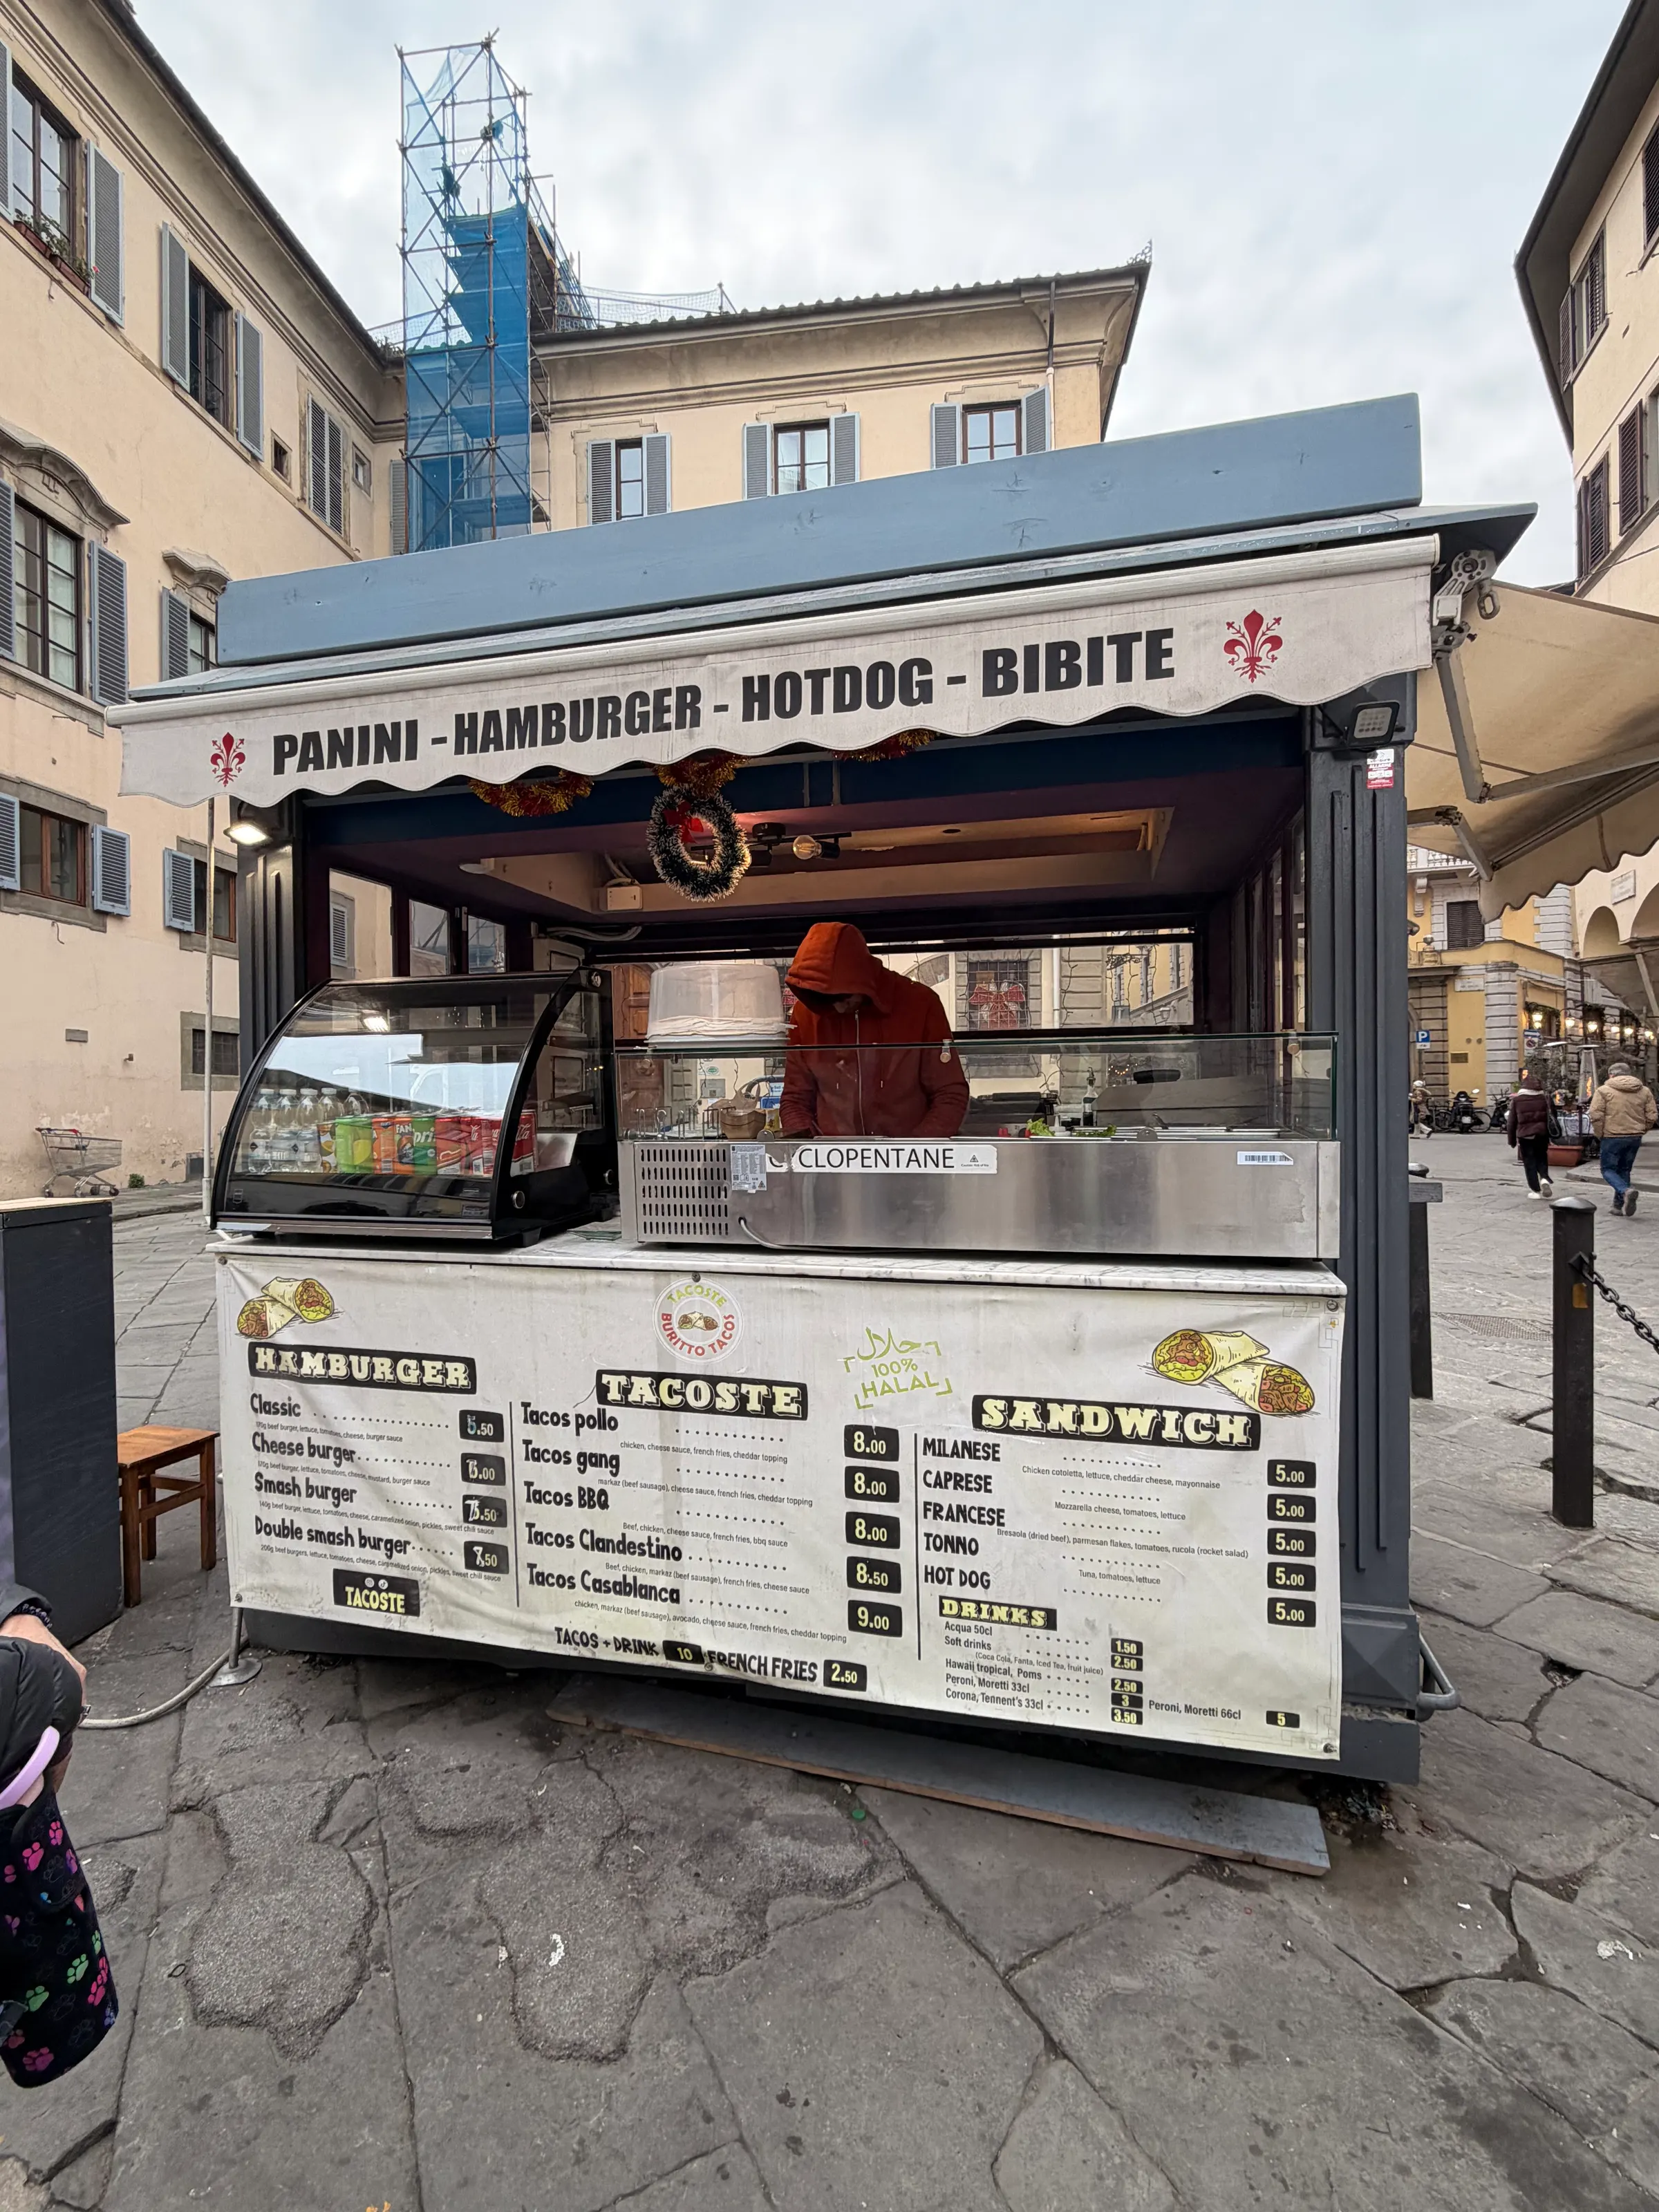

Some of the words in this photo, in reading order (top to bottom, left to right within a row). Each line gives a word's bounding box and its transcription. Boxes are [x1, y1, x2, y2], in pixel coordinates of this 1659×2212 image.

[274, 719, 418, 776] PANINI
[454, 684, 702, 756] HAMBURGER
[742, 657, 933, 722] HOTDOG
[982, 628, 1174, 697] BIBITE
[1418, 1031, 1427, 1042] P
[667, 1284, 727, 1308] TACOSTE
[661, 1313, 705, 1356] BURITTO
[708, 1314, 735, 1353] TACOS
[857, 1327, 921, 1360] حلال
[255, 1347, 471, 1389] HAMBURGER
[871, 1358, 918, 1378] 100%
[601, 1374, 802, 1418] TACOSTE
[861, 1371, 939, 1398] HALAL
[250, 1393, 301, 1417] Classic
[521, 1401, 571, 1427] Tacos
[574, 1407, 619, 1435] pollo
[981, 1398, 1252, 1447] SANDWICH
[252, 1431, 304, 1456] Cheese
[307, 1436, 356, 1468] burger
[620, 1441, 646, 1450] chicken,
[647, 1443, 671, 1452] cheese
[671, 1446, 692, 1454] sauce,
[693, 1446, 714, 1456] french
[715, 1448, 731, 1459] fries,
[733, 1450, 760, 1460] cheddar
[762, 1454, 787, 1465] topping
[854, 1432, 886, 1454] 8.00
[922, 1437, 1000, 1462] MILANESE
[522, 1438, 572, 1465] Tacos
[576, 1451, 620, 1477] gang
[854, 1472, 886, 1495] 8.00
[923, 1469, 993, 1494] CAPRESE
[1022, 1465, 1050, 1475] Chicken
[1051, 1469, 1084, 1479] cotoletta,
[1085, 1470, 1112, 1481] lettuce,
[1113, 1473, 1143, 1483] cheddar
[1145, 1476, 1174, 1486] cheese,
[1175, 1480, 1220, 1489] mayonnaise
[1275, 1464, 1304, 1483] 5.00
[254, 1471, 301, 1497] Smash
[305, 1477, 357, 1508] burger
[523, 1480, 573, 1507] Tacos
[577, 1485, 610, 1510] BBQ
[598, 1478, 621, 1486] markaz
[621, 1479, 638, 1492] (beef
[639, 1482, 670, 1492] sausage),
[671, 1484, 694, 1494] cheese
[695, 1488, 716, 1497] sauce,
[717, 1488, 738, 1498] french
[740, 1490, 756, 1501] fries,
[758, 1493, 785, 1503] cheddar
[786, 1497, 813, 1508] topping
[923, 1501, 1005, 1527] FRANCESE
[1055, 1501, 1092, 1512] Mozzarella
[1094, 1505, 1121, 1515] cheese,
[1123, 1508, 1159, 1519] tomatoes,
[1160, 1510, 1186, 1520] lettuce
[1275, 1498, 1304, 1517] 5.00
[254, 1515, 303, 1540] Double
[306, 1526, 355, 1547] smash
[357, 1527, 411, 1560] burger
[525, 1521, 574, 1549] Tacos
[579, 1528, 682, 1562] Clandestino
[623, 1521, 639, 1531] Beef,
[639, 1524, 666, 1535] chicken,
[666, 1527, 690, 1537] cheese
[691, 1531, 712, 1540] sauce,
[713, 1532, 734, 1541] french
[735, 1534, 752, 1544] fries,
[753, 1536, 767, 1546] bbq
[854, 1518, 887, 1541] 8.00
[924, 1532, 979, 1556] TONNO
[997, 1528, 1027, 1538] Bresaola
[1028, 1531, 1049, 1541] (dried
[1050, 1533, 1071, 1544] beef),
[1072, 1537, 1108, 1546] parmesan
[1109, 1539, 1133, 1550] flakes,
[1134, 1542, 1170, 1553] tomatoes,
[1172, 1546, 1195, 1554] rucola
[1197, 1546, 1223, 1556] (rocket
[1225, 1549, 1248, 1559] salad)
[1275, 1533, 1304, 1552] 5.00
[526, 1562, 576, 1590] Tacos
[580, 1569, 680, 1604] Casablanca
[856, 1562, 888, 1586] 8.50
[924, 1564, 955, 1586] HOT
[959, 1568, 991, 1590] DOG
[1078, 1569, 1097, 1579] Tuna,
[1098, 1572, 1134, 1583] tomatoes,
[1136, 1575, 1161, 1584] lettuce
[1275, 1566, 1304, 1586] 5.00
[345, 1586, 405, 1613] TACOSTE
[941, 1598, 1047, 1624] DRINKS
[857, 1606, 889, 1630] 9.00
[1275, 1602, 1304, 1622] 5.00
[944, 1620, 971, 1634] Acqua
[974, 1624, 992, 1636] 50cl
[554, 1627, 599, 1648] TACOS
[613, 1635, 659, 1656] DRINK
[677, 1647, 693, 1660] 10
[944, 1635, 962, 1647] Soft
[964, 1638, 991, 1651] drinks
[1115, 1640, 1136, 1654] 1.50
[706, 1650, 768, 1676] FRENCH
[771, 1657, 818, 1683] FRIES
[831, 1662, 857, 1684] 2.50
[946, 1658, 975, 1673] Hawaii
[976, 1662, 1013, 1678] tropical,
[1017, 1667, 1042, 1680] Poms
[1114, 1656, 1136, 1669] 2.50
[946, 1673, 975, 1687] Peroni,
[977, 1677, 1009, 1690] Moretti
[1011, 1682, 1029, 1693] 33cl
[1114, 1678, 1136, 1692] 2.50
[946, 1687, 979, 1703] Corona,
[980, 1691, 1022, 1707] Tennent's
[1024, 1698, 1043, 1710] 33cl
[1121, 1694, 1129, 1707] 3
[1149, 1699, 1181, 1714] Peroni,
[1184, 1704, 1218, 1717] Moretti
[1221, 1708, 1241, 1720] 66cl
[1114, 1709, 1136, 1724] 3.50
[1277, 1712, 1286, 1726] 5
